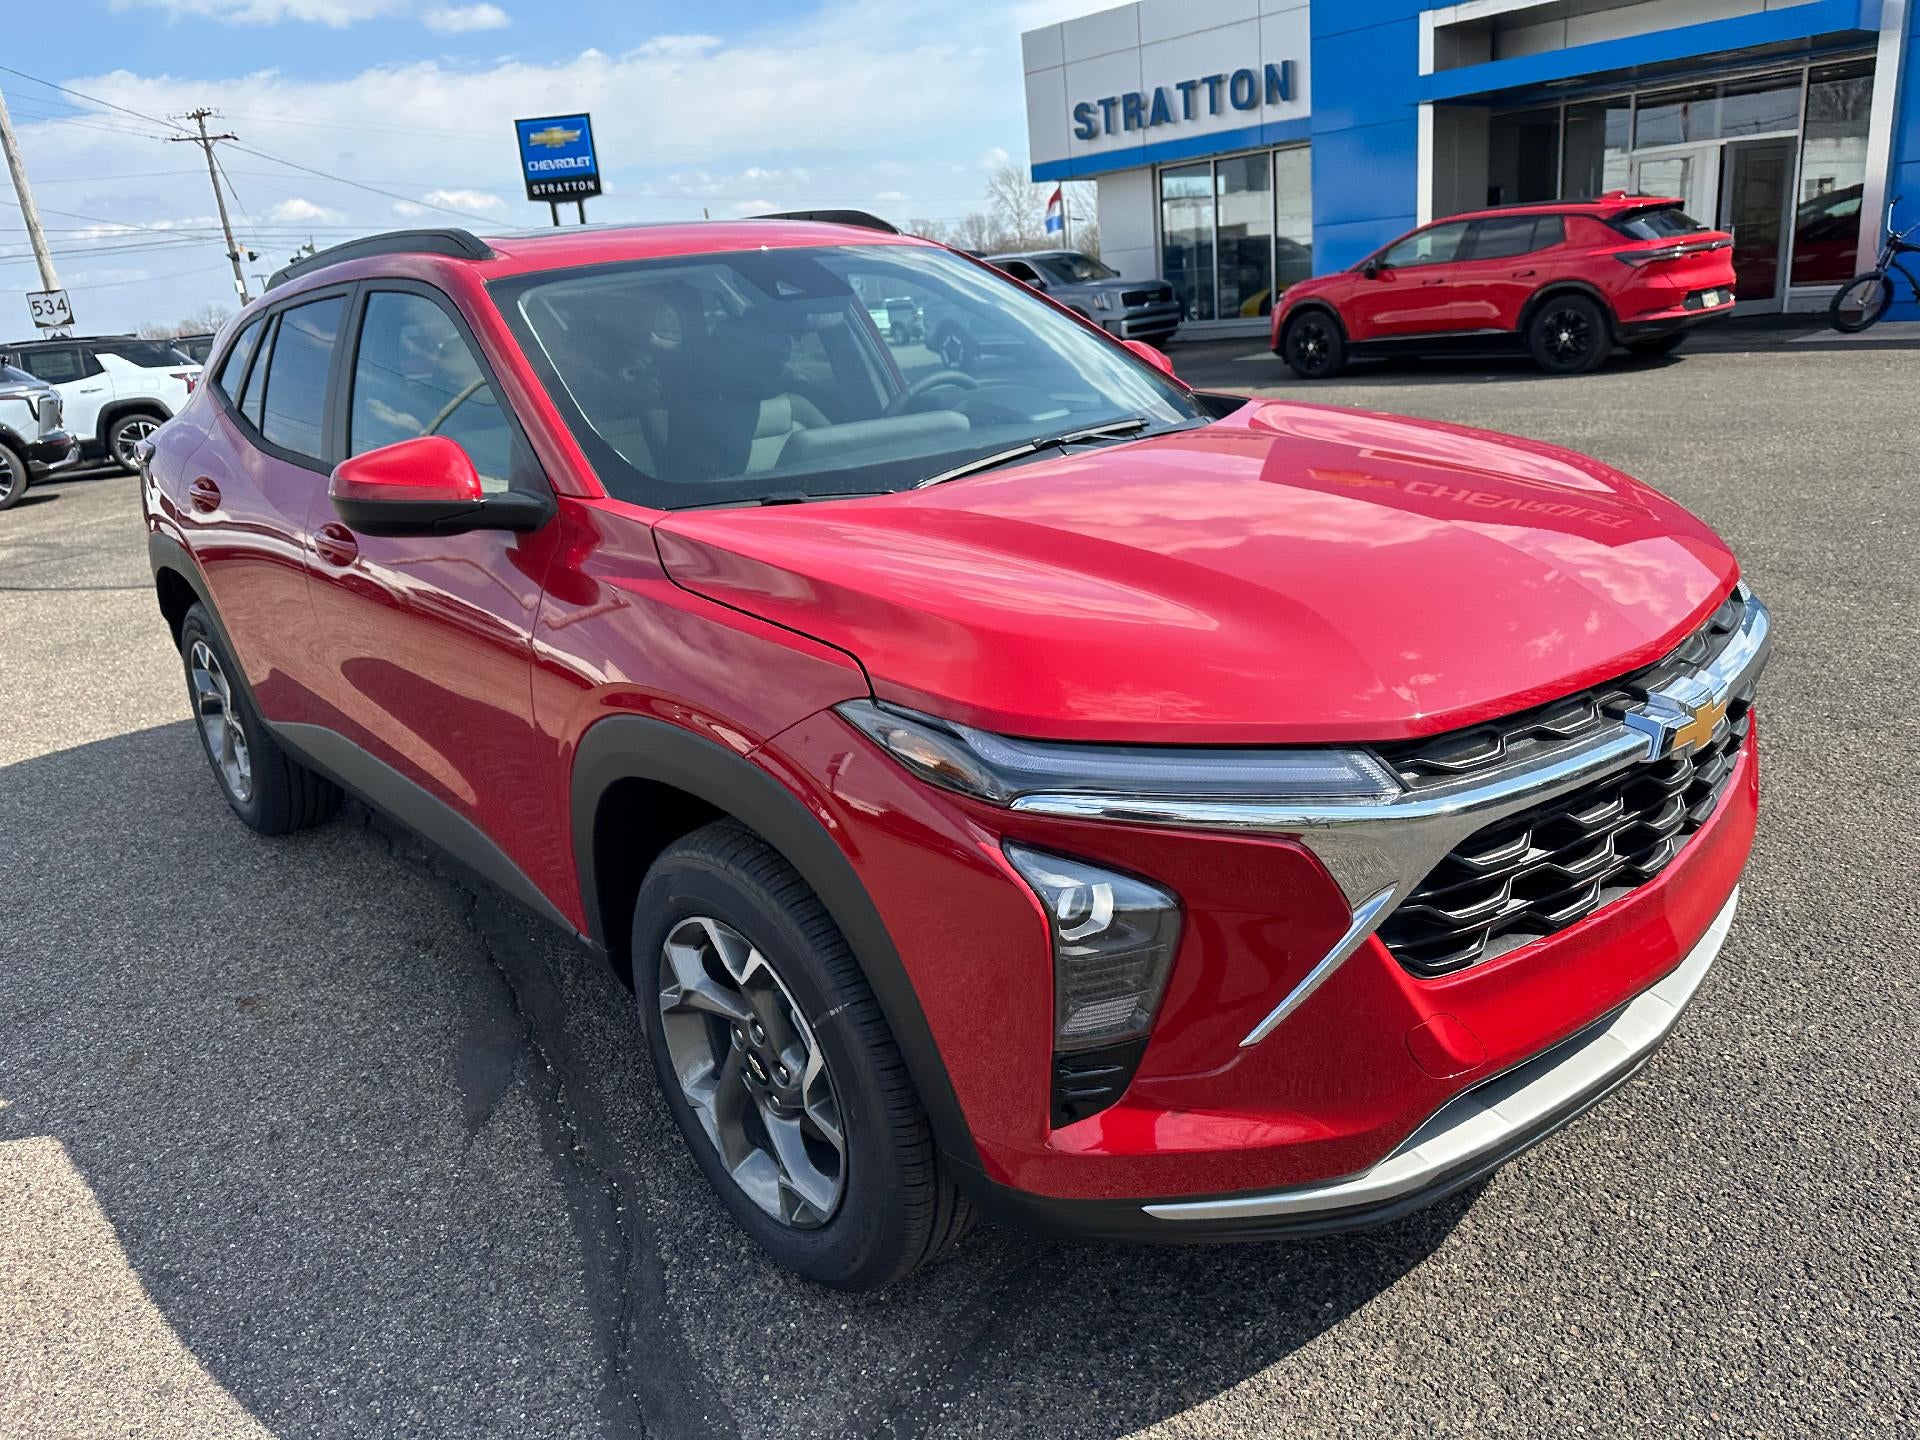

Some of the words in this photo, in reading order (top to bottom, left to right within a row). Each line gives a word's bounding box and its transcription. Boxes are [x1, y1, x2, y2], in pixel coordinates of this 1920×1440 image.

[1073, 60, 1296, 140] STRATTON
[528, 156, 591, 171] CHEVROLET
[532, 180, 595, 195] STRATTON
[31, 298, 67, 317] 534
